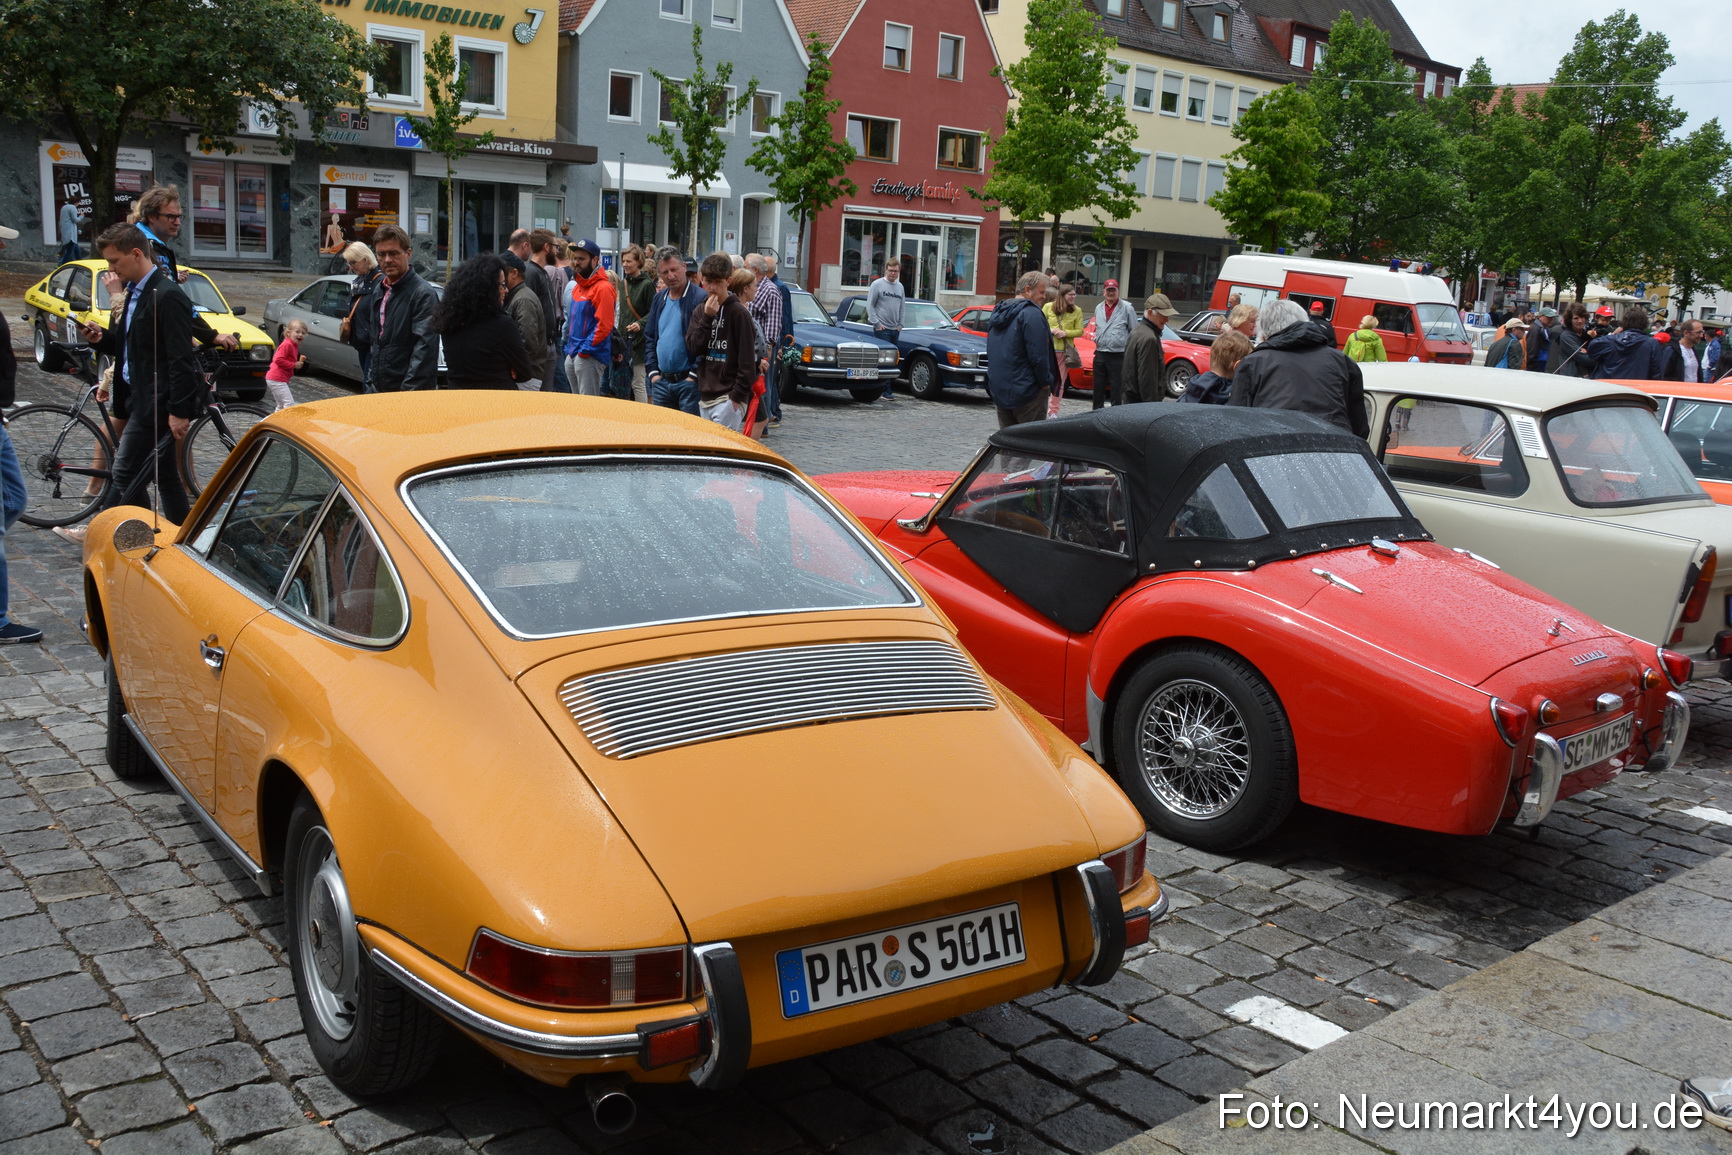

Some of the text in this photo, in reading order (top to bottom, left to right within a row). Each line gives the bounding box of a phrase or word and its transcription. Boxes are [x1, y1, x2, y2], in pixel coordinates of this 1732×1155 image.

[364, 0, 505, 30] IMMOBILIEN
[63, 182, 89, 199] IPL
[1564, 717, 1634, 770] SC MM 52H
[789, 910, 1023, 1004] D PAR S 501H
